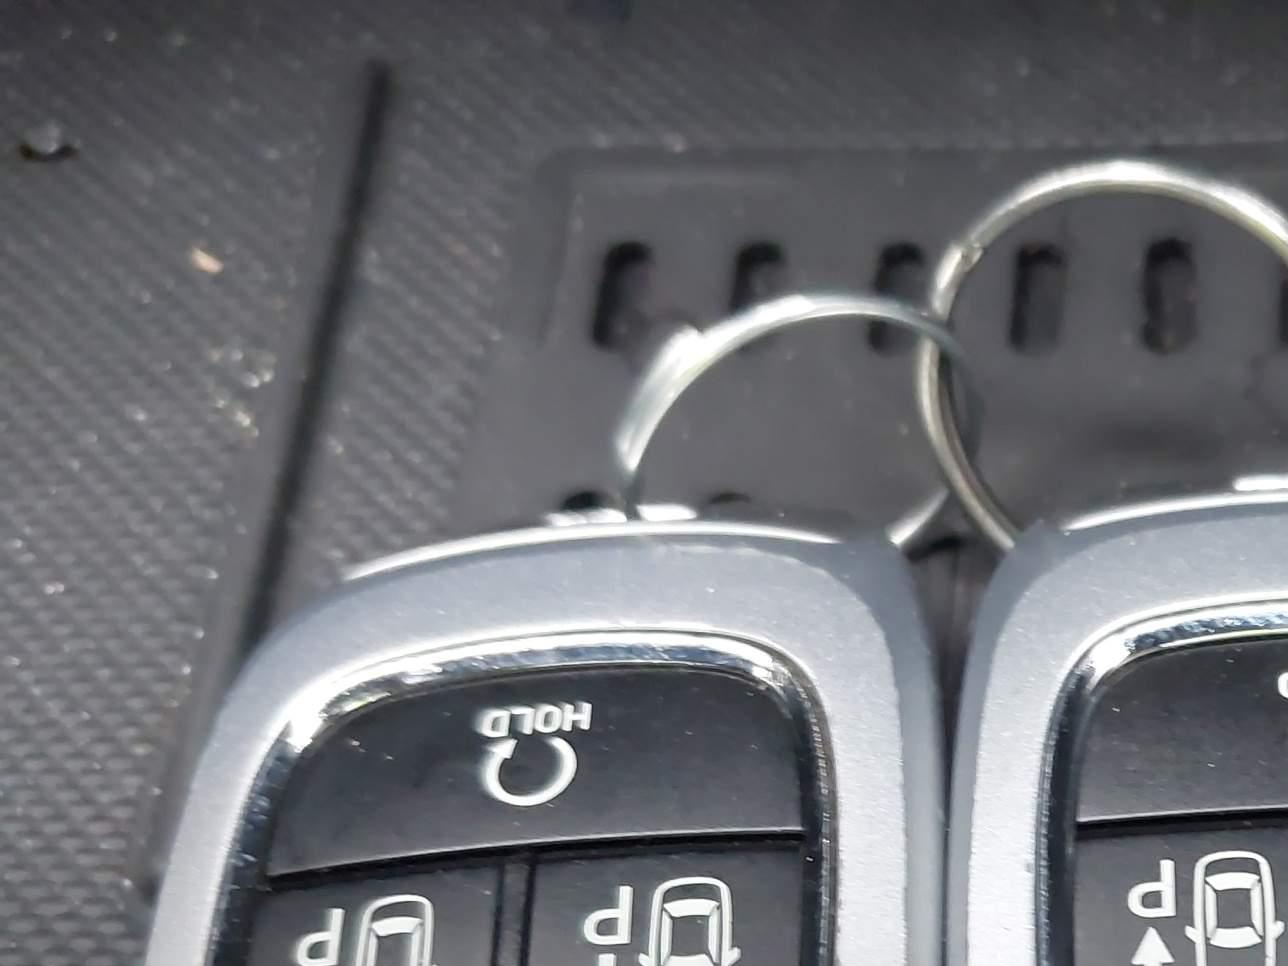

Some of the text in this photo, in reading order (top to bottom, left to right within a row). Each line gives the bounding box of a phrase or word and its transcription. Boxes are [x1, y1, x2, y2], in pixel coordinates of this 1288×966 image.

[482, 702, 592, 738] HOLD
[583, 885, 634, 946] P
[1126, 859, 1177, 919] P
